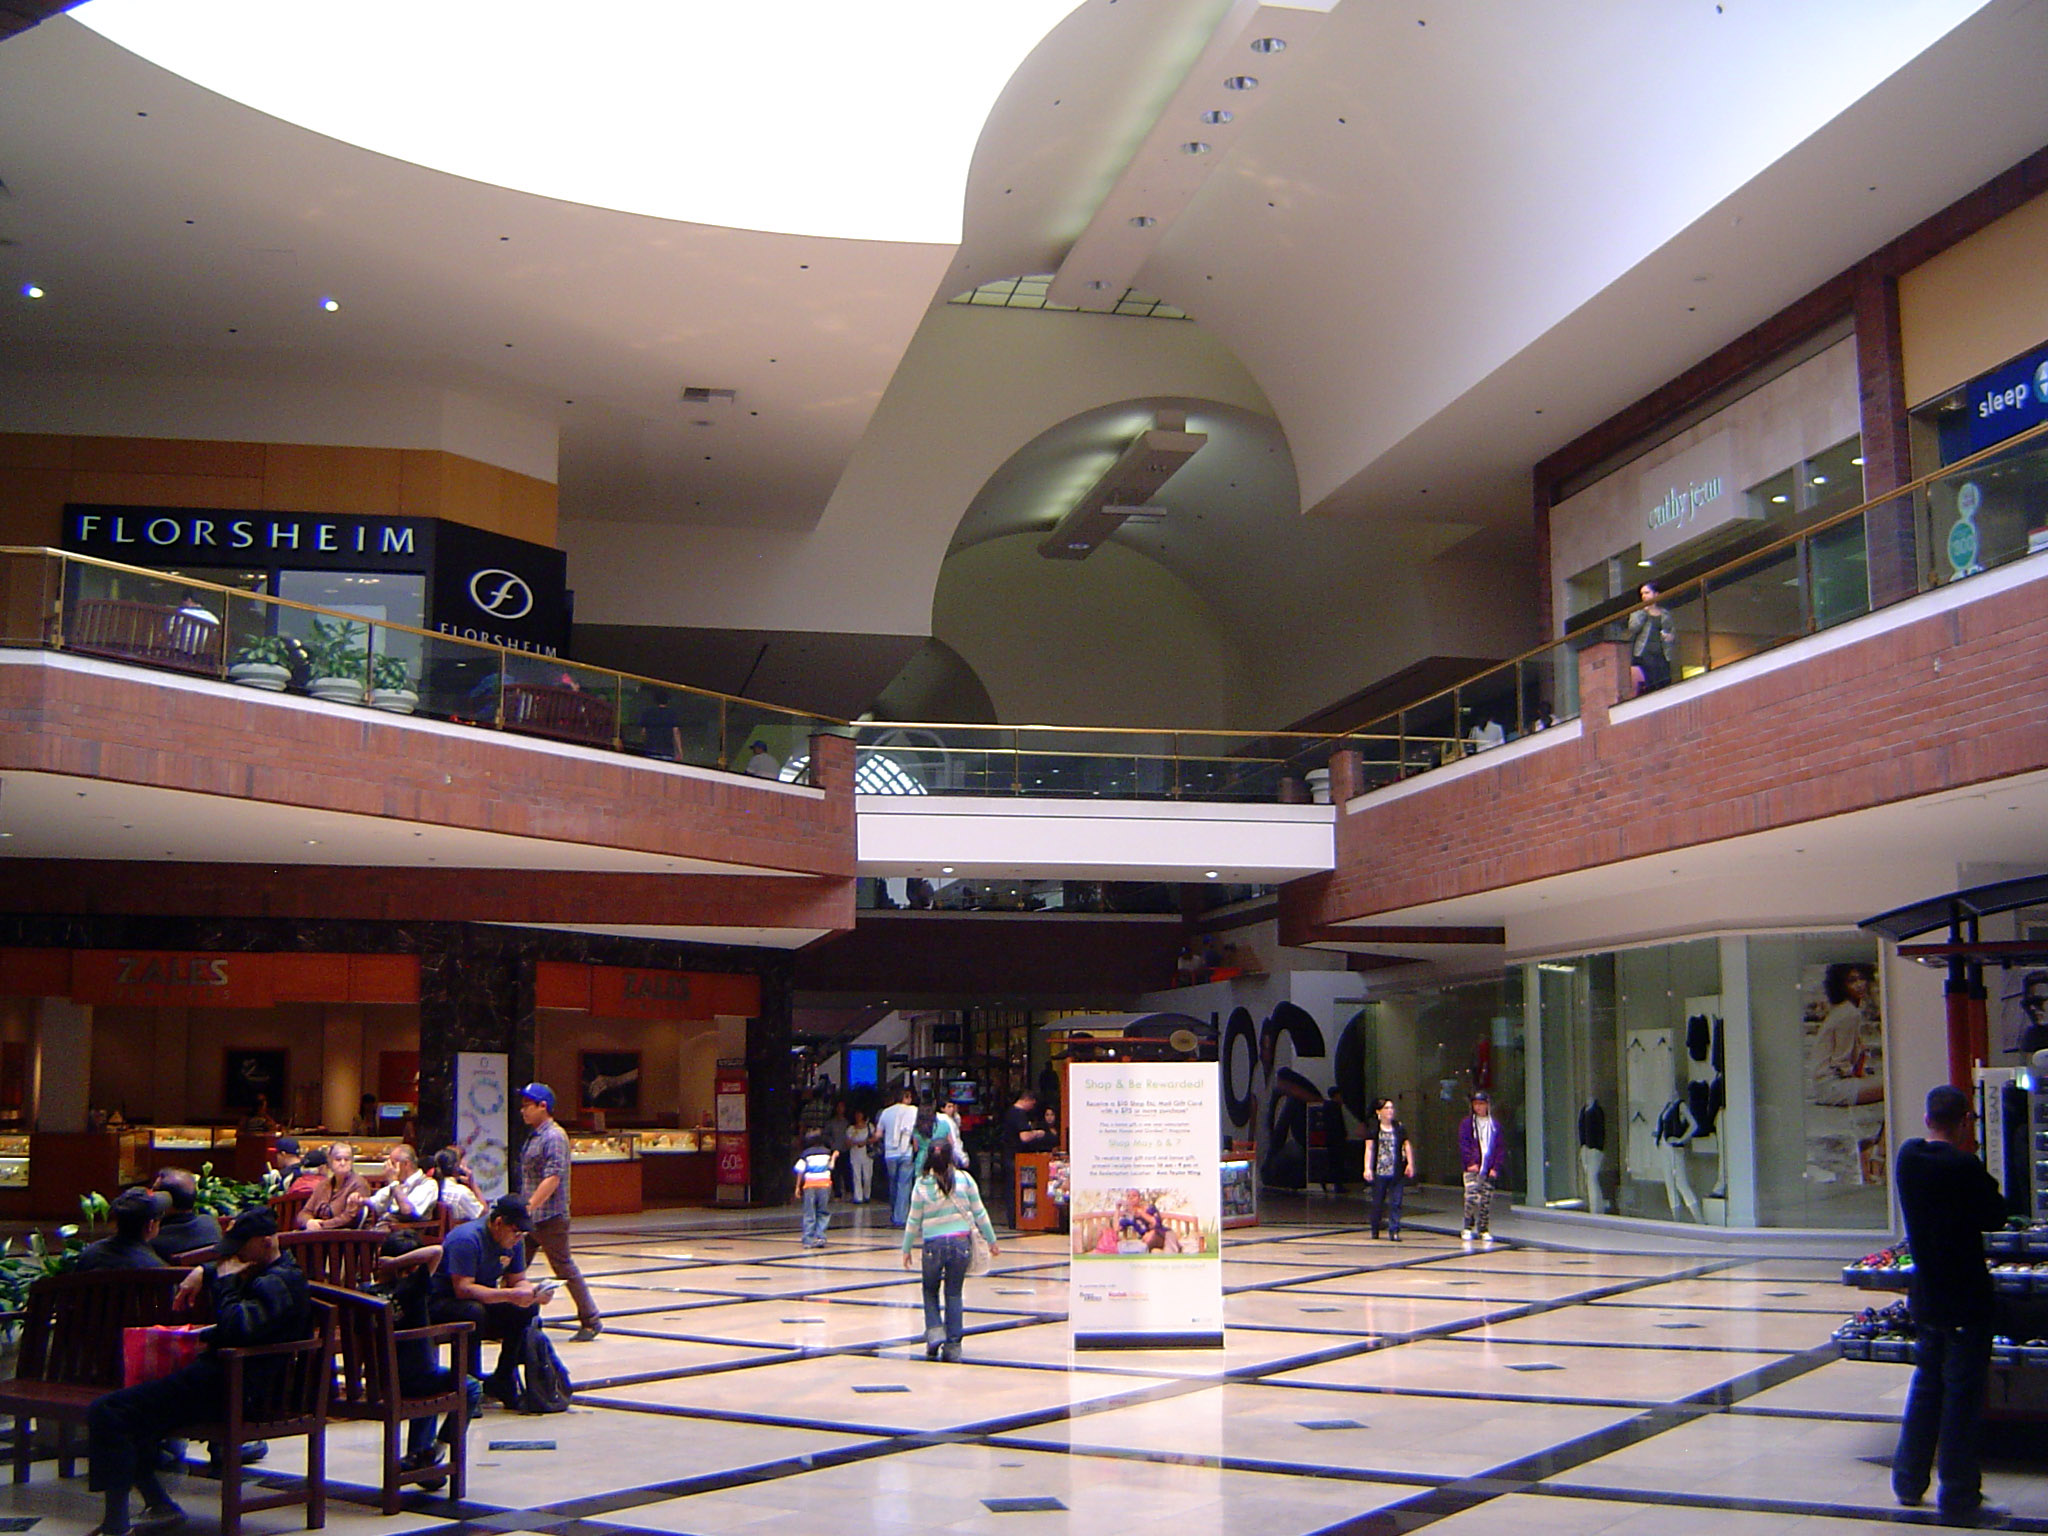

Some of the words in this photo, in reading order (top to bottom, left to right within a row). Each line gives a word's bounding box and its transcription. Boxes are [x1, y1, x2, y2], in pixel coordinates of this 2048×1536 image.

[1979, 384, 2027, 418] sleep
[1648, 487, 1687, 528] cathy
[80, 515, 415, 553] FLORSHEIM
[116, 956, 229, 986] ZALES
[1085, 1079, 1112, 1091] Shop
[1116, 1079, 1124, 1091] &
[1128, 1079, 1142, 1091] Be
[1146, 1079, 1204, 1091] Rewarded!
